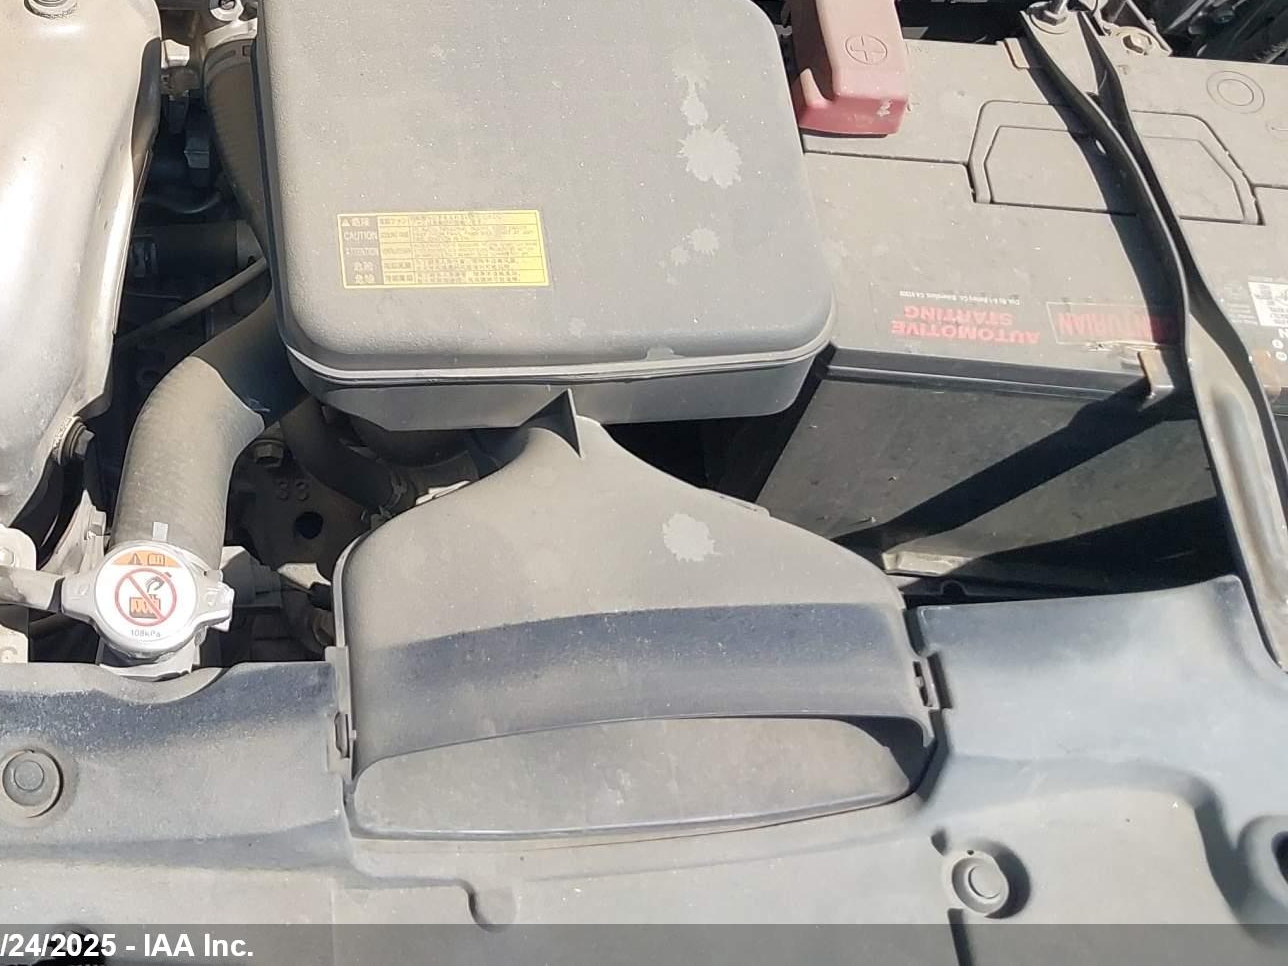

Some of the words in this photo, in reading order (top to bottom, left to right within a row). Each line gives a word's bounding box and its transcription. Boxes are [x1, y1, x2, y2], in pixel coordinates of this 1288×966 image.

[344, 230, 377, 241] CAUTION
[903, 305, 1014, 326] STARTING
[890, 320, 1040, 344] AUTOMOTIVE
